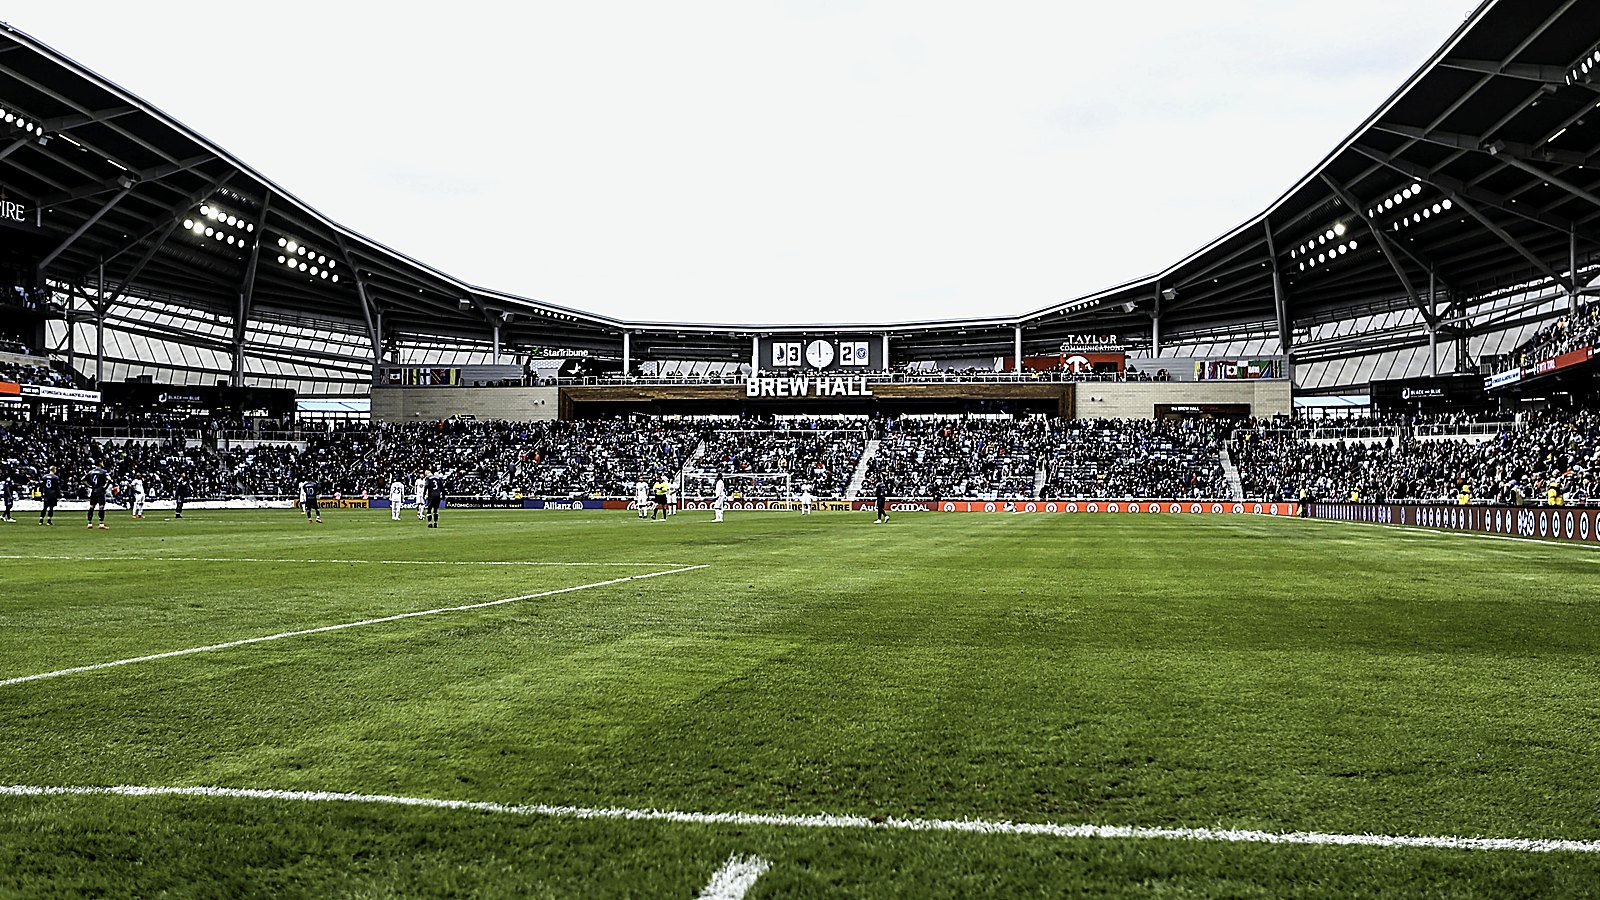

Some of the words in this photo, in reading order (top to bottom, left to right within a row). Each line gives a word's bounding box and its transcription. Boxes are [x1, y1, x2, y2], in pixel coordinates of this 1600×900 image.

[0, 200, 25, 222] IRE
[1067, 334, 1117, 345] TAYLOR
[543, 348, 588, 357] StarTribune
[1059, 344, 1125, 352] COMMUNICATIONS
[789, 346, 799, 362] 3
[842, 346, 852, 361] 2
[746, 377, 809, 397] BREW
[815, 377, 873, 396] HALL
[543, 501, 572, 510] Allianz
[829, 503, 850, 511] TIRE
[859, 503, 879, 511] Aud
